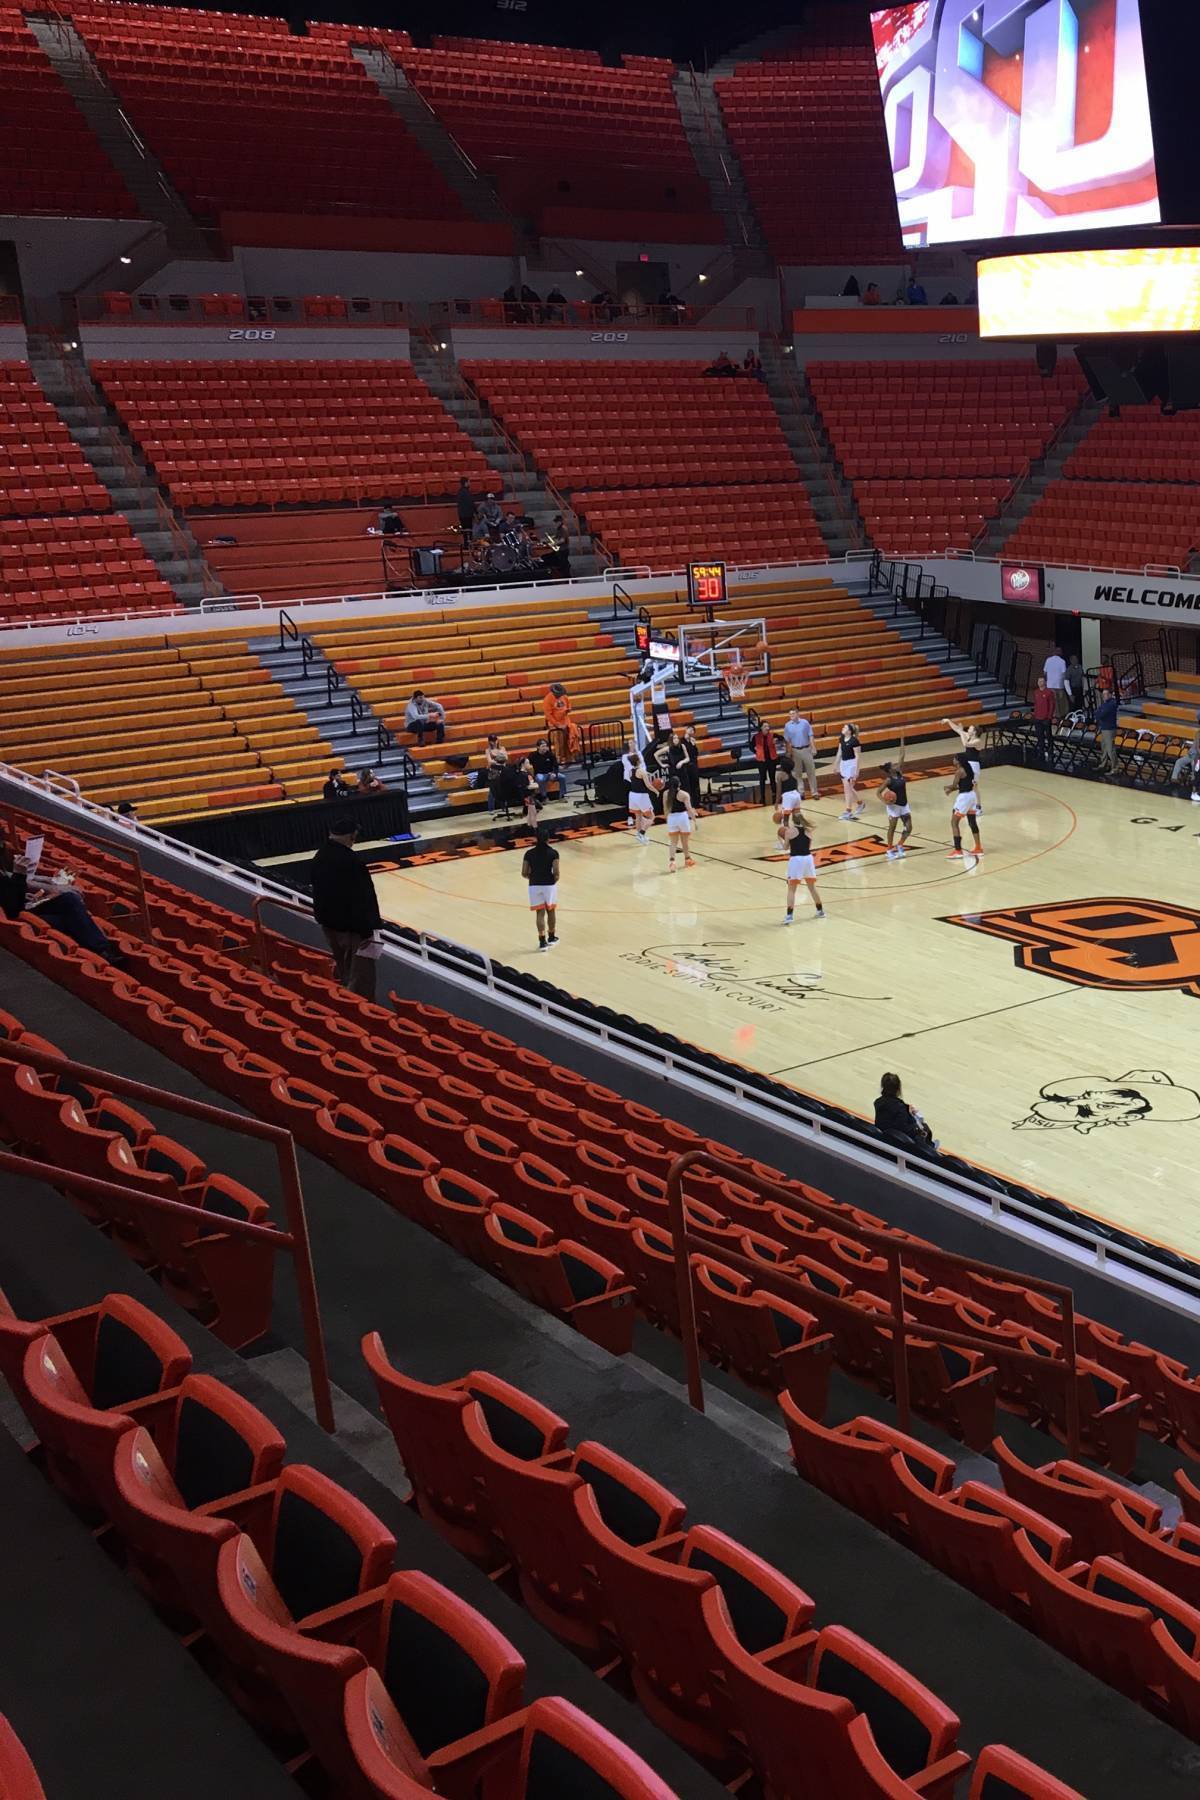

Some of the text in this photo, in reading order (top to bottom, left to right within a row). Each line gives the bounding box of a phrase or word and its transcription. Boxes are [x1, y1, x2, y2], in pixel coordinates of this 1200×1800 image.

[228, 328, 276, 341] 208
[590, 332, 629, 342] 209
[939, 333, 968, 343] 210
[692, 566, 722, 579] 59:44
[698, 578, 720, 599] 30
[619, 951, 787, 1014] EDDIE SUTTON COURT
